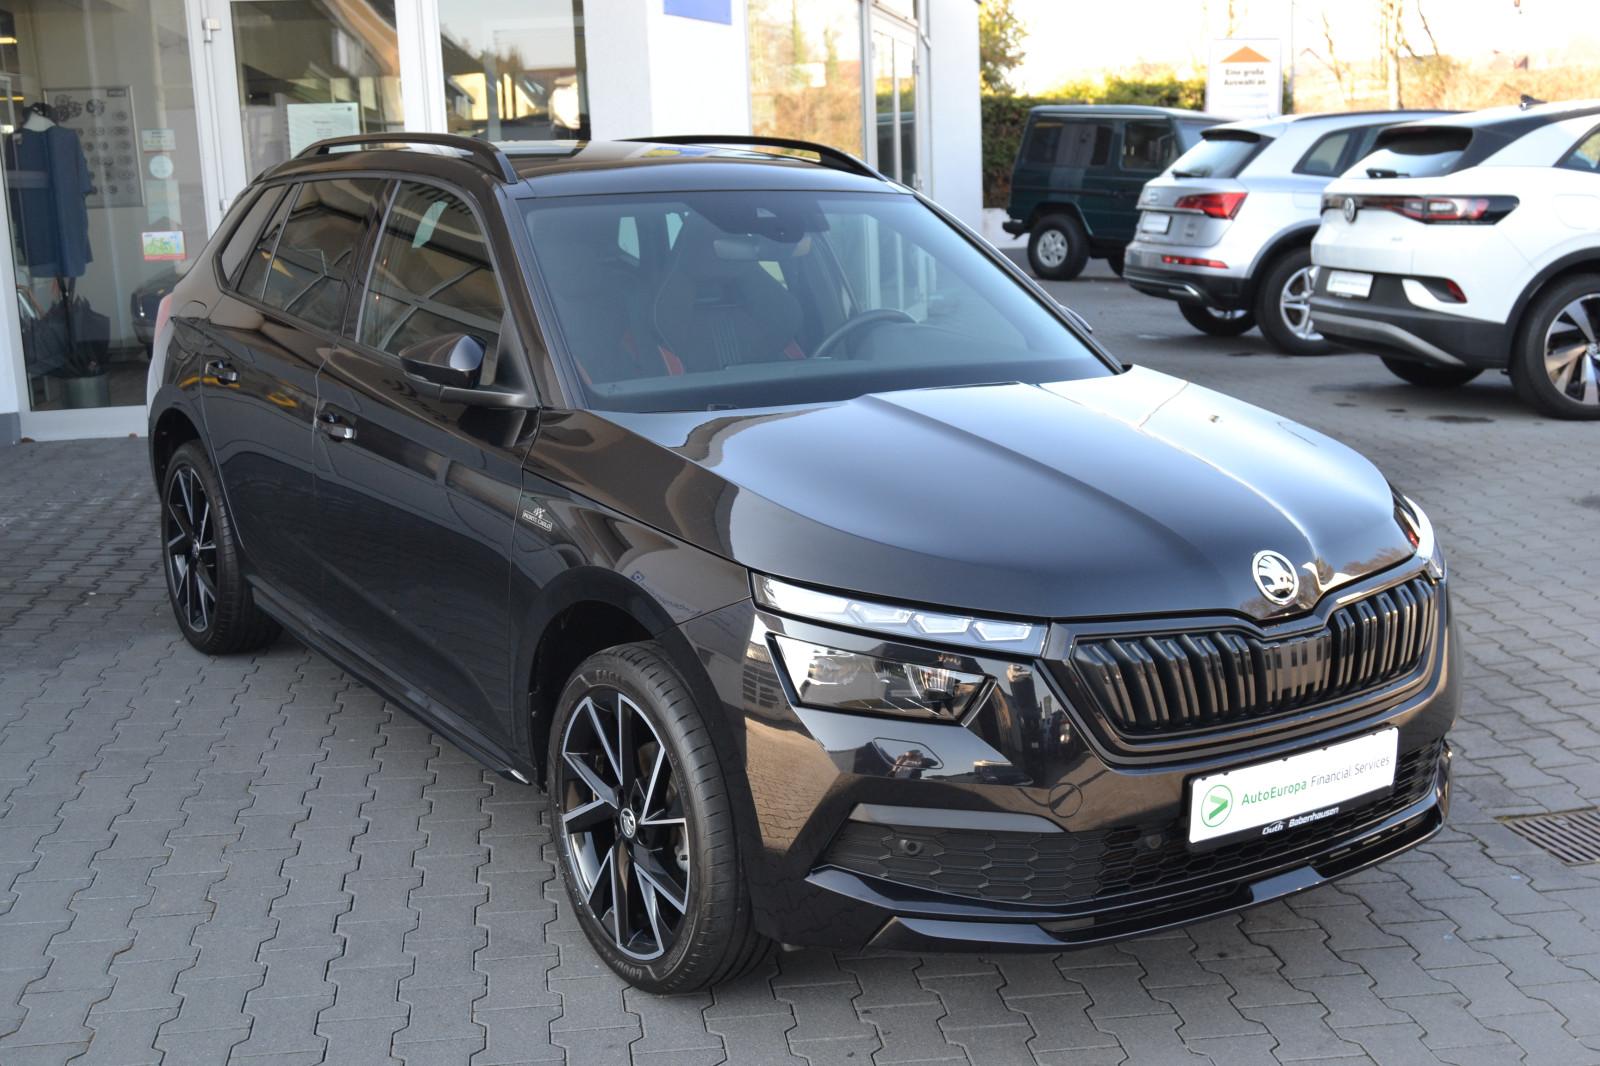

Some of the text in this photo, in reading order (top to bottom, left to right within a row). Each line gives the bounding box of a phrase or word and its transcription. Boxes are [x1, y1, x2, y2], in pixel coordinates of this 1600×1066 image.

[1241, 755, 1390, 805] AutoEuropa Financial Services
